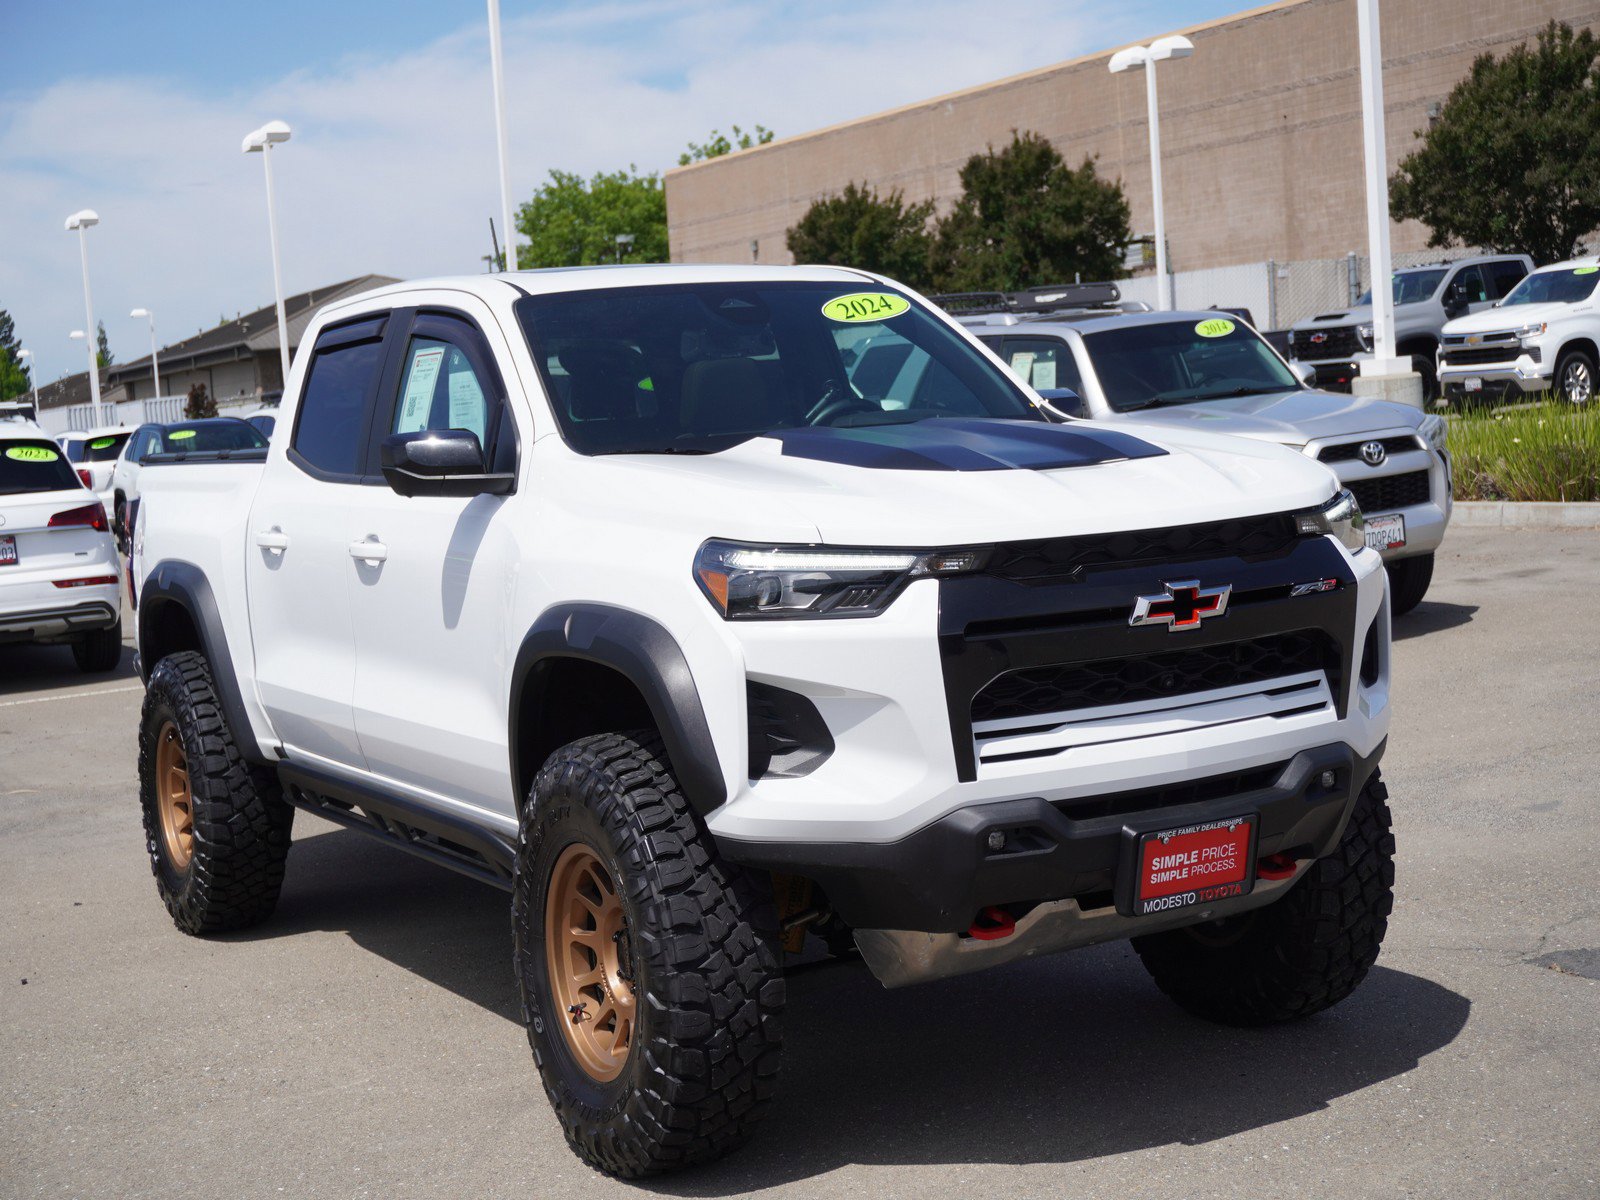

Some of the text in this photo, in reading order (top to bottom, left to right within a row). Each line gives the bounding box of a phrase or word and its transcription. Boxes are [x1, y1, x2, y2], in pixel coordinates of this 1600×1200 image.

[837, 296, 892, 319] 2024
[1204, 322, 1228, 335] 2014
[16, 449, 49, 459] 2023
[1366, 528, 1402, 547] 7DQP641
[1157, 818, 1244, 840] PRICE FAMILY DEALERSHIPS
[1152, 843, 1238, 871] SIMPLE PRICE.
[1150, 858, 1237, 884] SIMPLE PROCESS.
[1143, 884, 1242, 914] MODESTO TOYOTA
